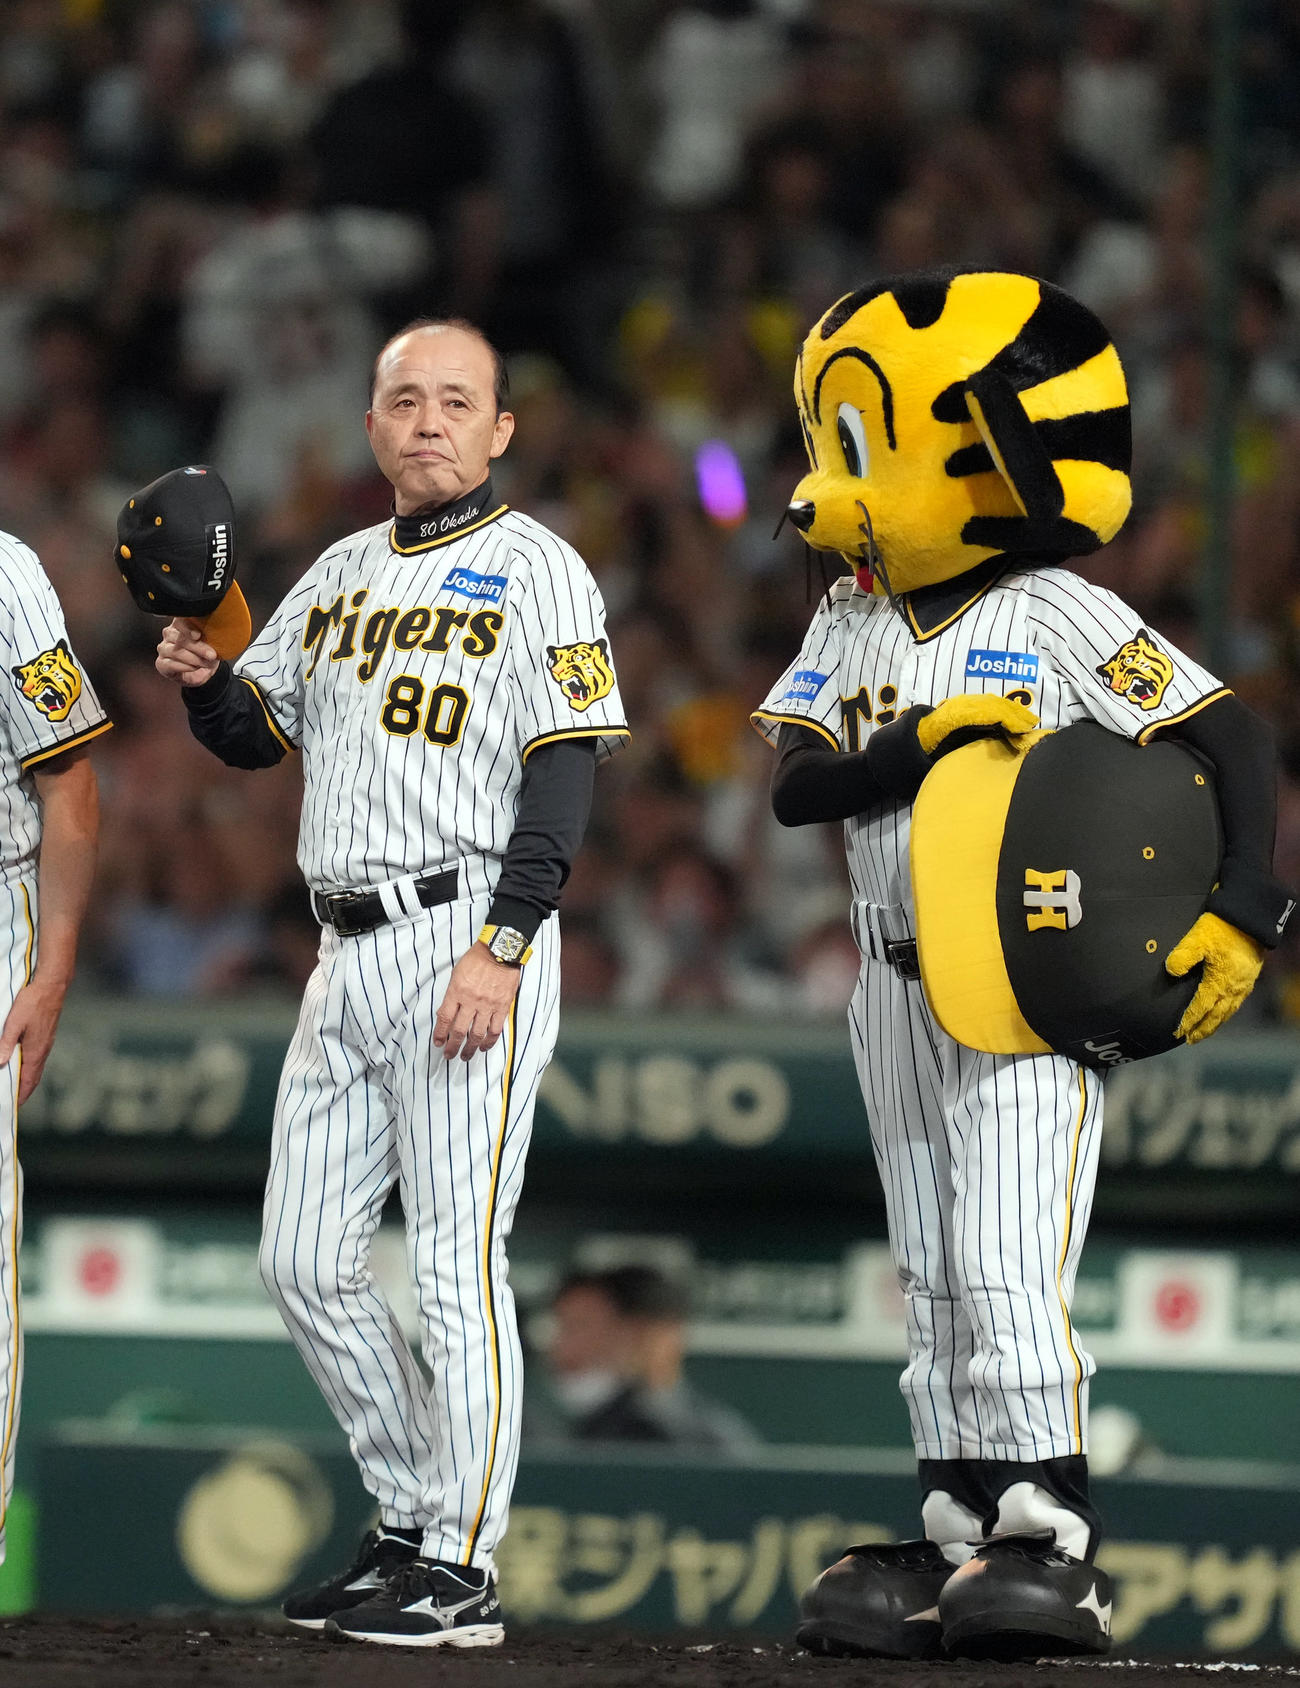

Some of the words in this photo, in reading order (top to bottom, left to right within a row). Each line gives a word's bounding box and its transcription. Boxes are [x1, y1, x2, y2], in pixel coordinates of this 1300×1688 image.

[420, 521, 437, 538] 80
[440, 505, 479, 532] Okada
[207, 524, 228, 591] Joshin
[444, 571, 503, 598] Joshin
[302, 588, 505, 684] Tigers
[967, 654, 1037, 678] Joshin
[380, 673, 472, 748] 80
[1095, 1541, 1300, 1650] アサ
